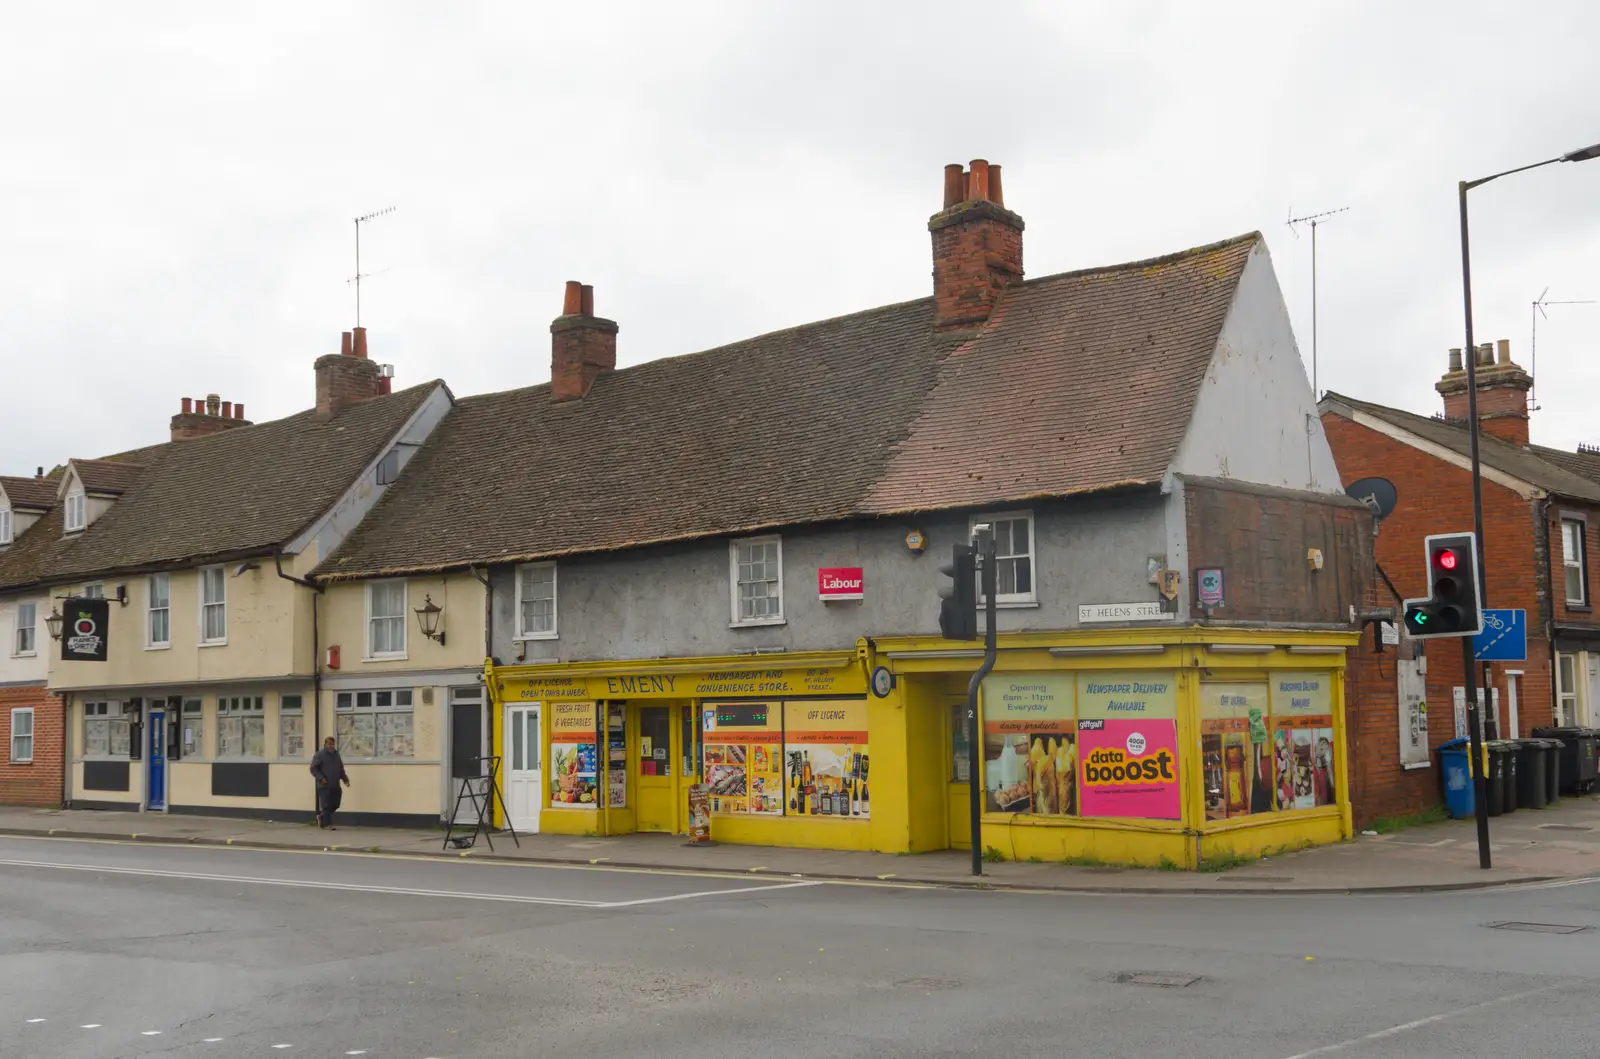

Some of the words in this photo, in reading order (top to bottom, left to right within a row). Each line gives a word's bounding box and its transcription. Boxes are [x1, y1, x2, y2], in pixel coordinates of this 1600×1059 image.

[823, 578, 862, 589] Labour
[1081, 609, 1091, 618] ST
[1097, 607, 1131, 617] HELENS
[1136, 606, 1168, 616] STRE
[528, 678, 543, 687] OFF
[544, 678, 573, 687] LICENCE
[607, 675, 676, 694] EMENY
[521, 690, 539, 698] OPEN
[545, 689, 560, 697] DAYS
[566, 688, 586, 697] WEEK
[696, 684, 755, 693] CONVENIENCE
[1009, 684, 1048, 693] Opening
[1086, 683, 1131, 694] NEWSPAPER
[1133, 682, 1168, 694] DELIVERY
[1031, 694, 1054, 702] 11pm
[556, 704, 573, 714] FRESH
[573, 703, 591, 713] FRUIT
[1007, 703, 1048, 712] Everyday
[1107, 700, 1147, 712] AVAILABLE
[808, 710, 819, 720] OFF
[820, 710, 846, 720] LICENCE
[967, 709, 974, 718] 2
[560, 717, 593, 727] VEGETABLES
[999, 722, 1021, 733] dairy
[1023, 720, 1059, 733] products
[1079, 720, 1103, 729] giffgaff
[1128, 737, 1145, 745] 40GB
[1091, 751, 1123, 764] data
[1085, 751, 1173, 782] booost
